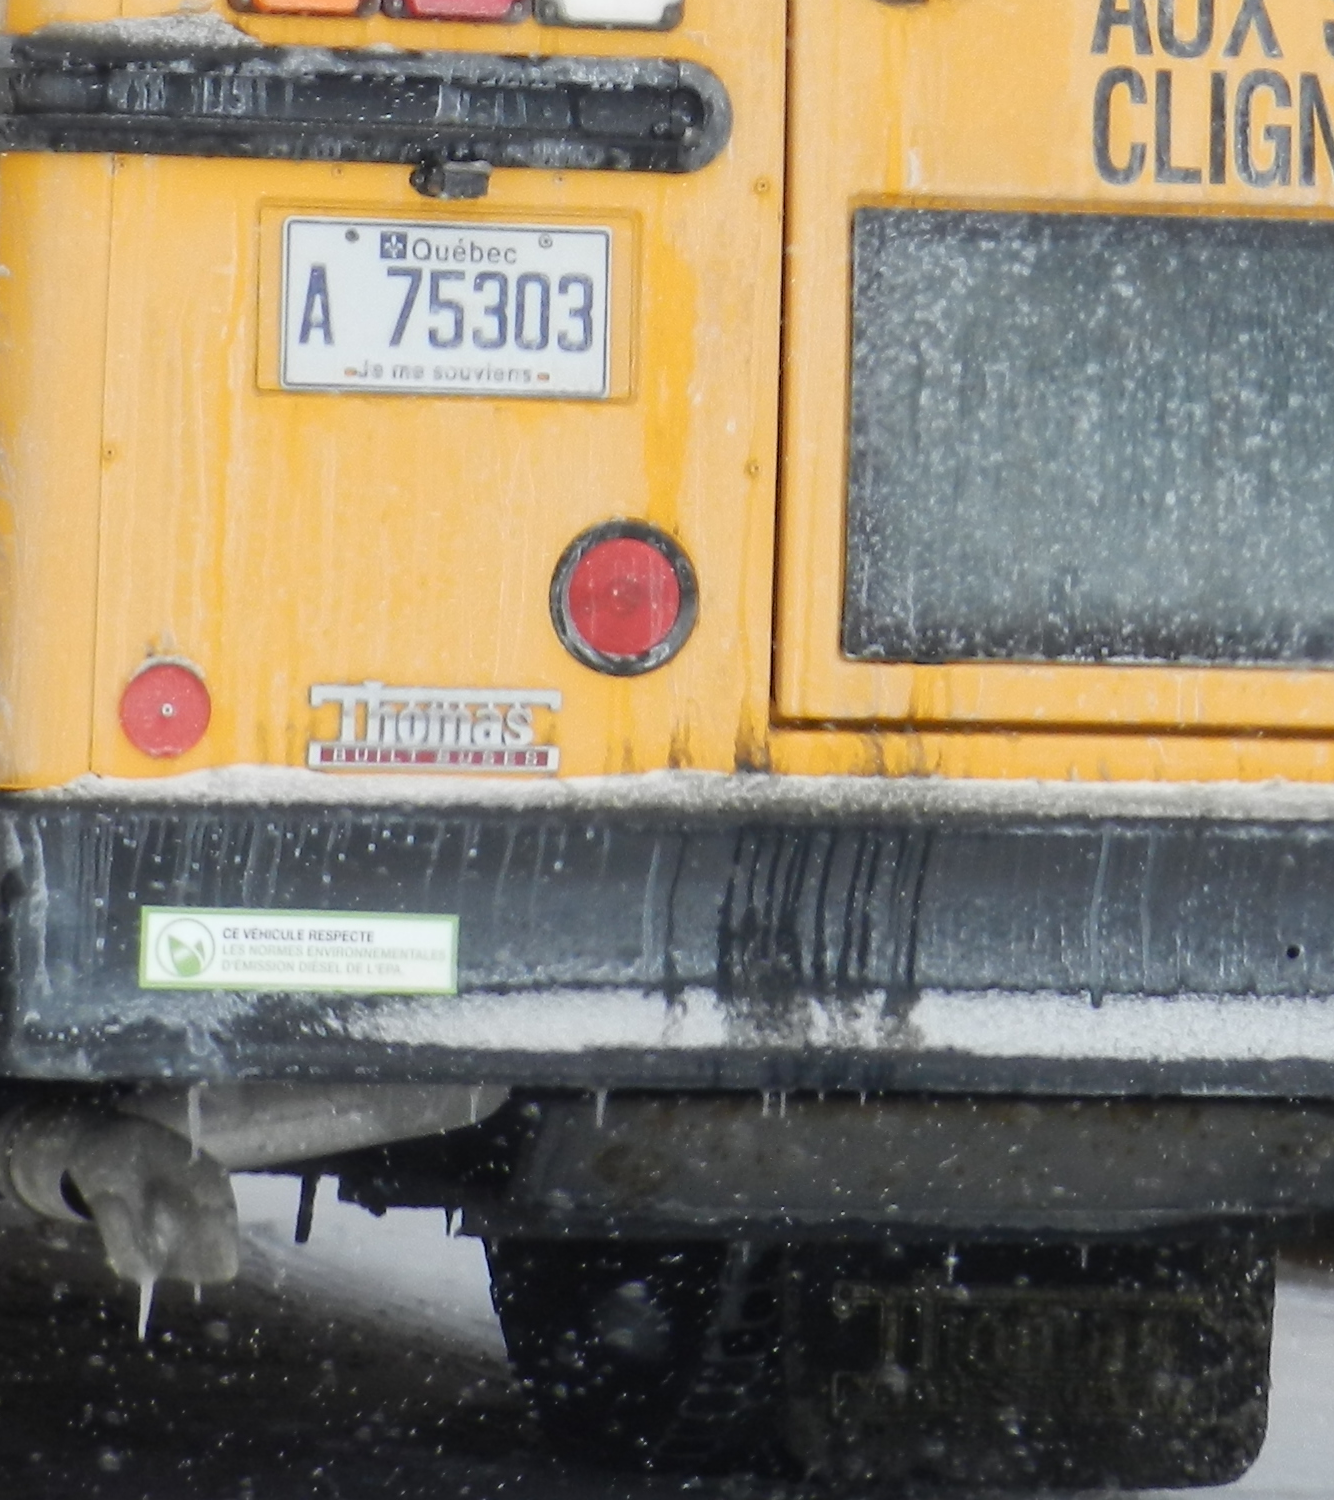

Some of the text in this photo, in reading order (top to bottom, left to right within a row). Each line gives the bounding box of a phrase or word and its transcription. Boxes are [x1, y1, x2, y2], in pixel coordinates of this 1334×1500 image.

[411, 237, 518, 265] Québec
[298, 262, 595, 352] A 75303
[309, 681, 562, 747] Thomas
[222, 927, 240, 940] CE
[308, 929, 374, 942] RESPECTE
